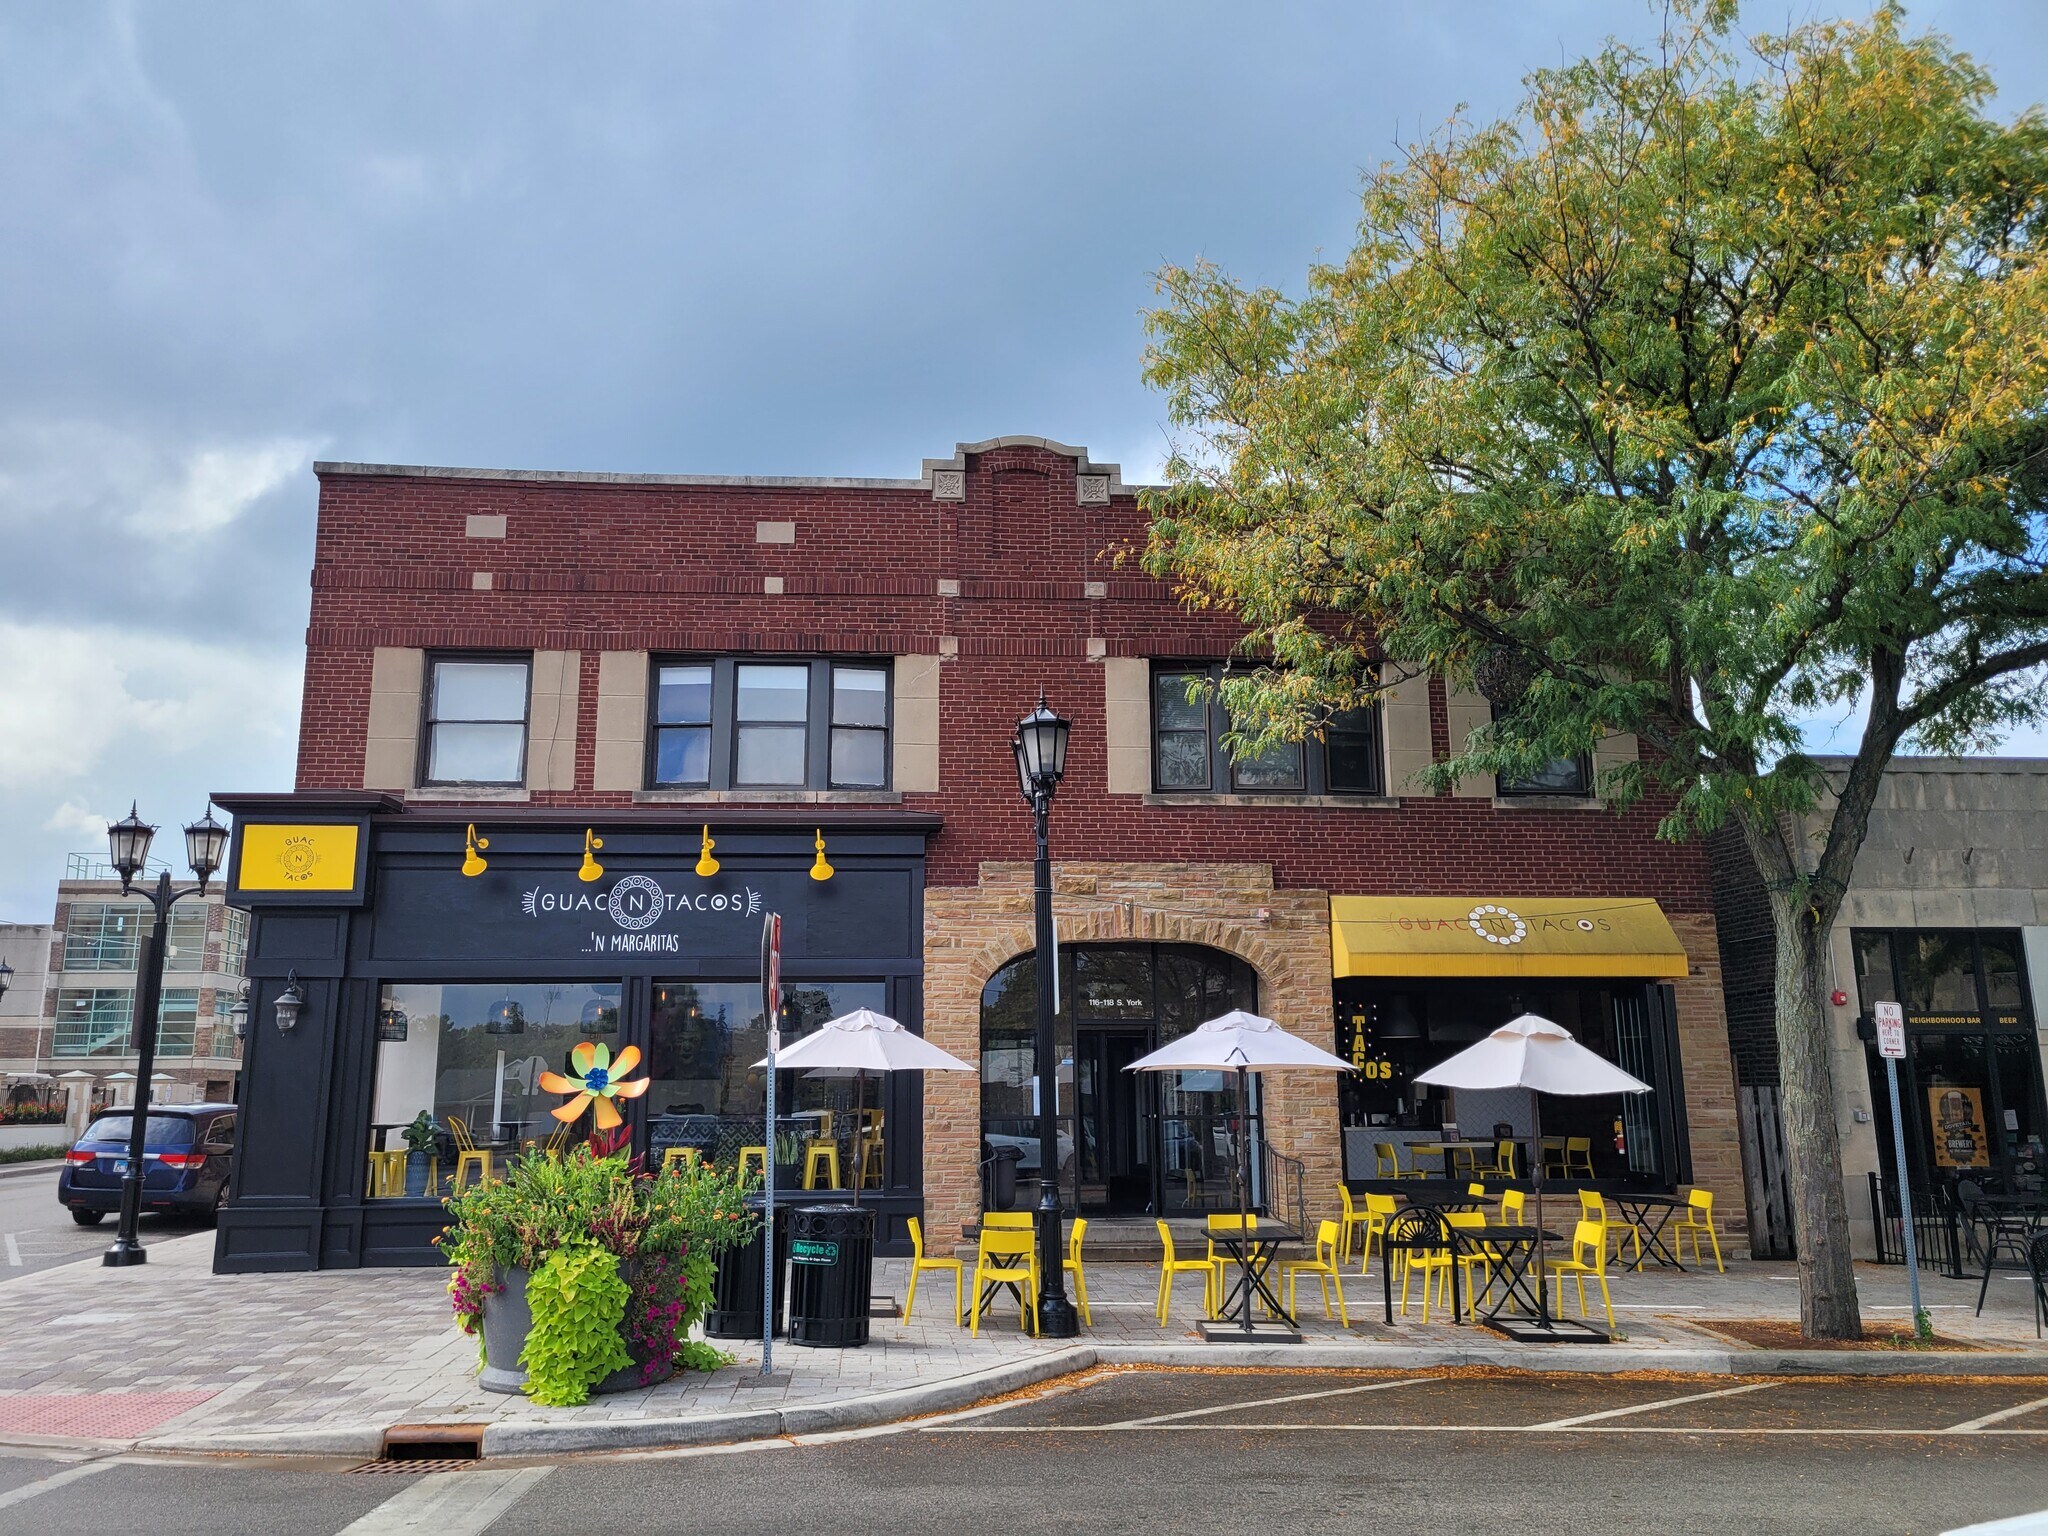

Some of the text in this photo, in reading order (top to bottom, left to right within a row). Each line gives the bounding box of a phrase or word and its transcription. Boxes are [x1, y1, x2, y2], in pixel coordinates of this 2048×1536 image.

[285, 836, 315, 846] GUAC
[283, 871, 313, 881] TACOS
[541, 893, 742, 911] GUAC N TACOS
[1398, 917, 1612, 932] GUAC N TACOS
[611, 933, 679, 952] MARGARITAS
[1883, 1006, 1894, 1017] NO
[1879, 1017, 1902, 1028] PARKING
[1909, 1016, 1981, 1024] NEIGHBORHOOD BAR
[1999, 1016, 2018, 1024] BEER
[1883, 1037, 1900, 1045] CORNER
[1352, 1015, 1392, 1079] TACOS
[1948, 1140, 1973, 1149] BREWERY
[796, 1243, 825, 1256] Recycle
